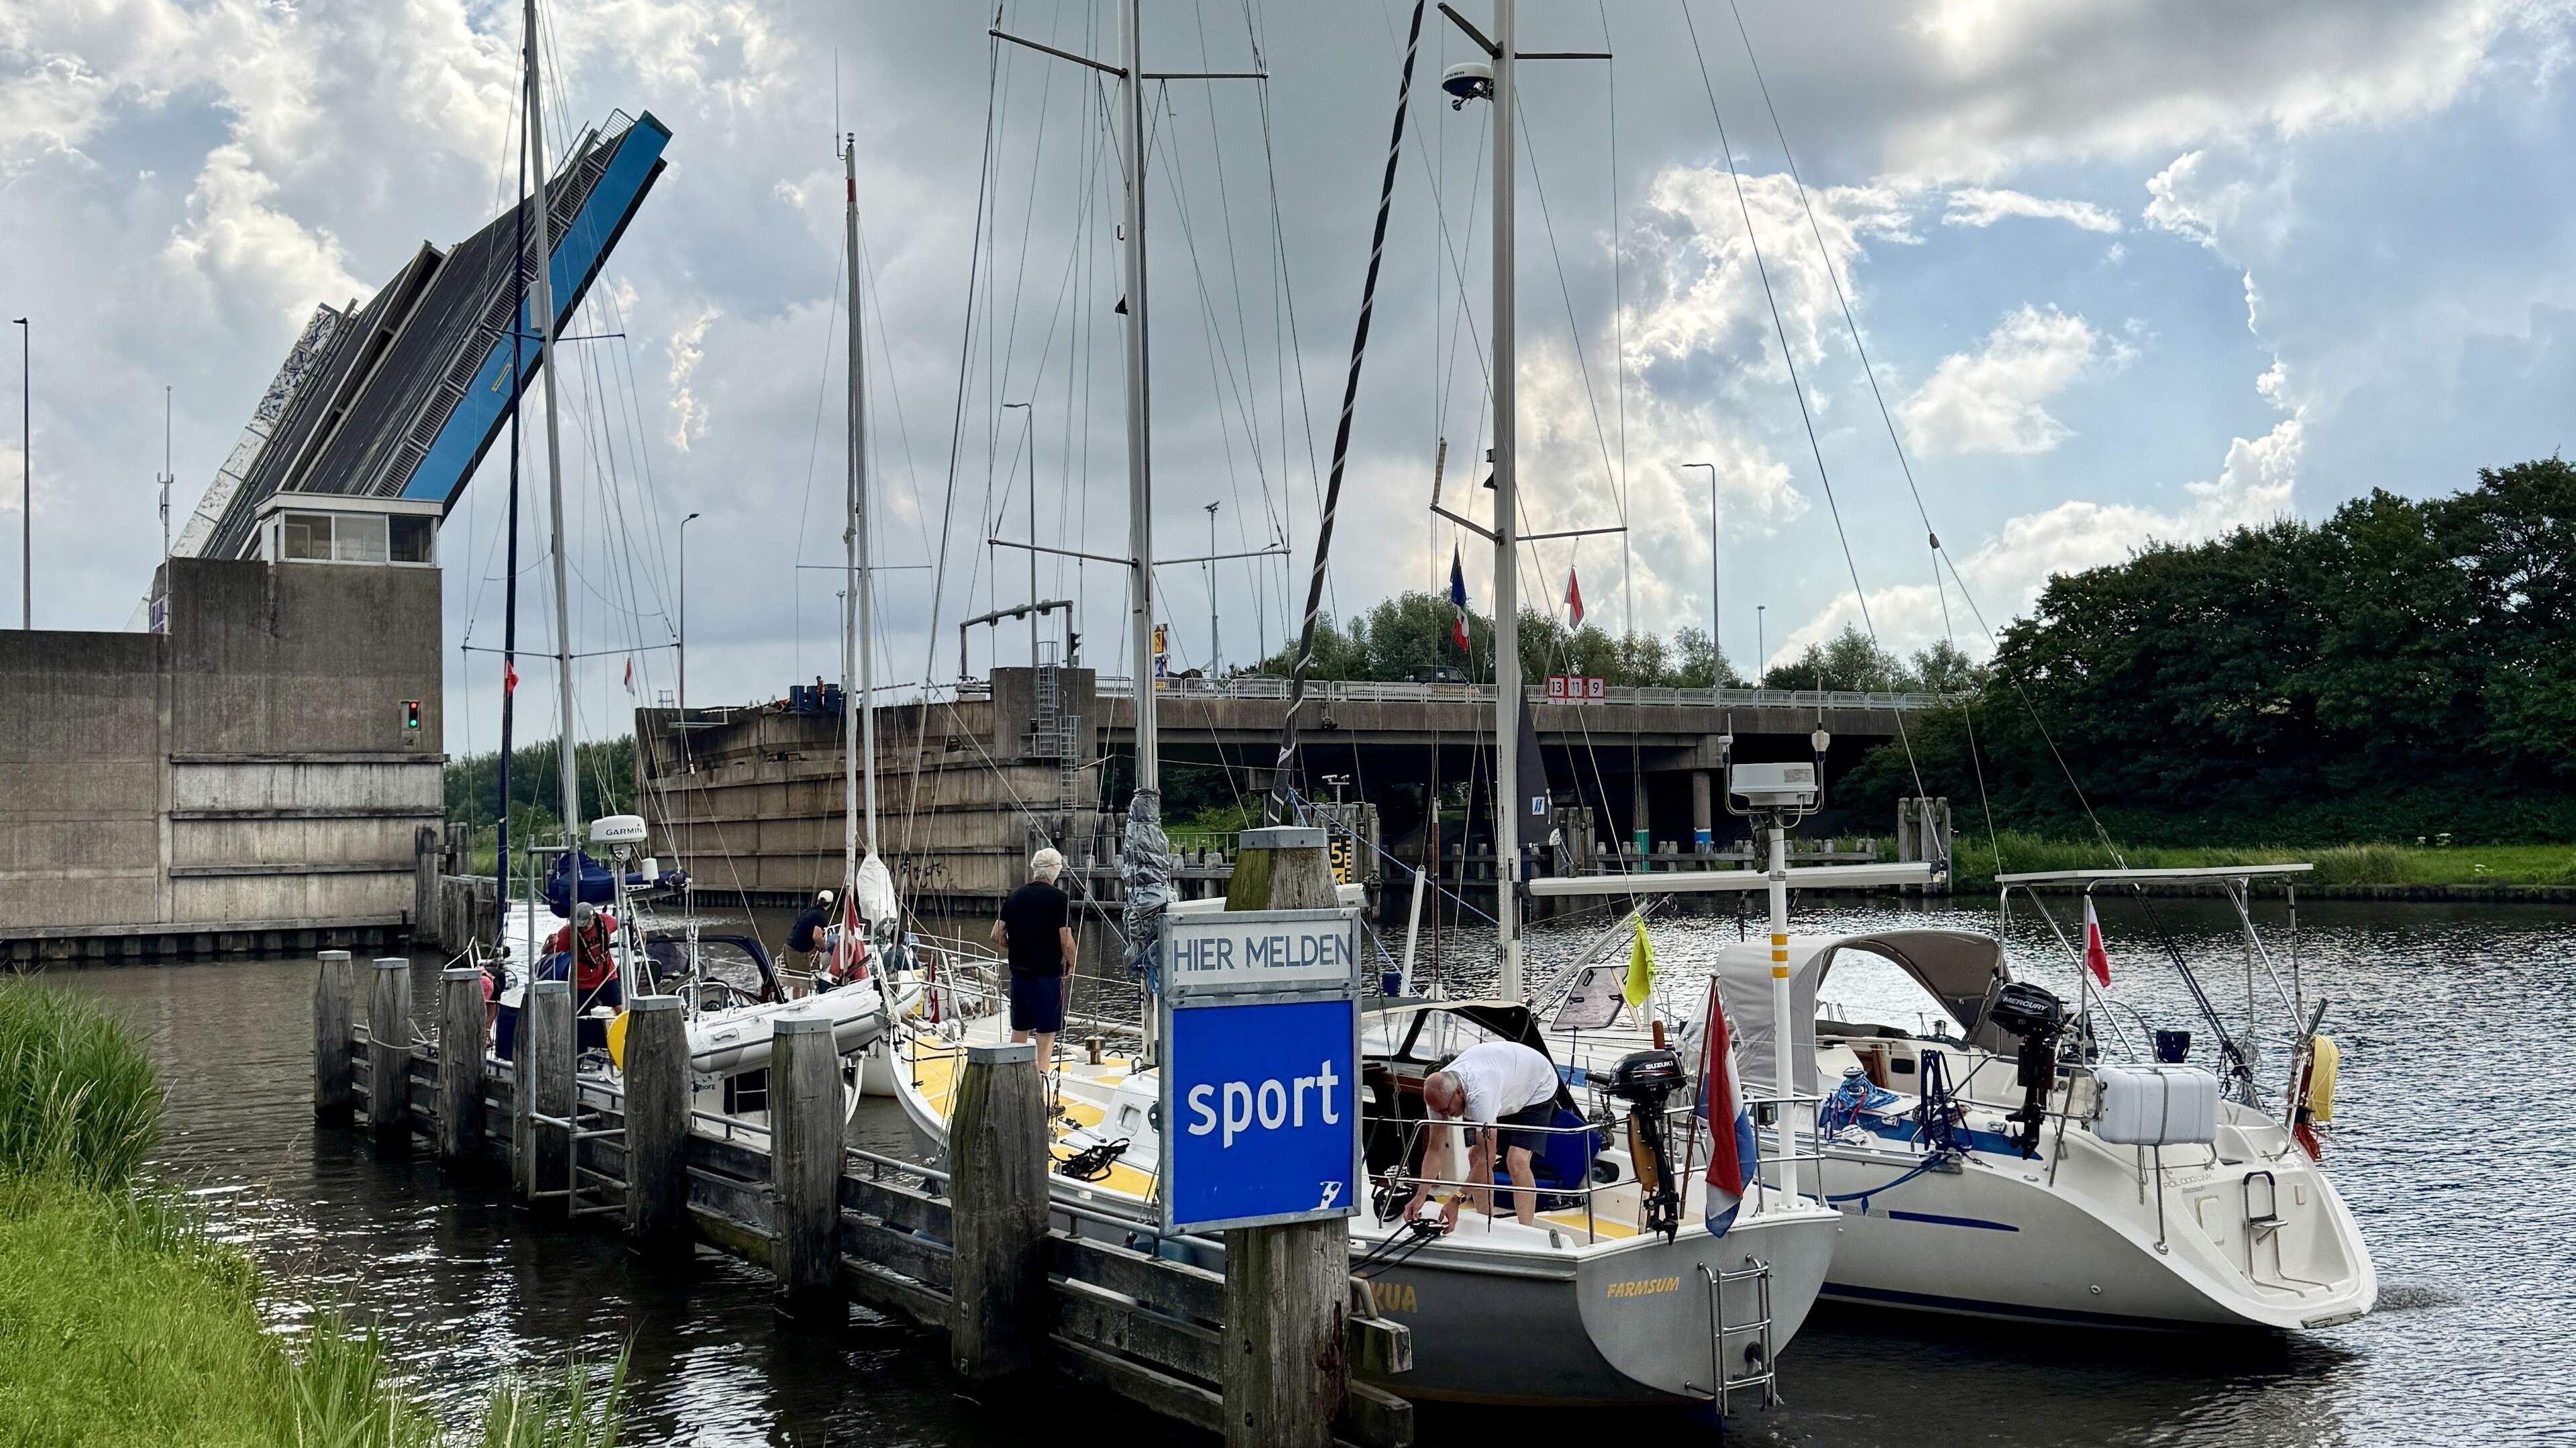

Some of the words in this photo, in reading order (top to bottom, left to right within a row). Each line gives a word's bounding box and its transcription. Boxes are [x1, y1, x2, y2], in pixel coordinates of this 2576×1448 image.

[1552, 681, 1562, 693] 13
[1593, 682, 1599, 693] 9
[606, 828, 643, 836] GARMIN
[1331, 842, 1343, 864] 5
[1174, 938, 1235, 972] HIER
[1246, 934, 1351, 968] MELDEN
[2002, 997, 2048, 1011] MERCURY
[1645, 1060, 1673, 1070] SUZUKI
[1188, 1060, 1339, 1149] sport
[1607, 1276, 1680, 1298] FARMSUM
